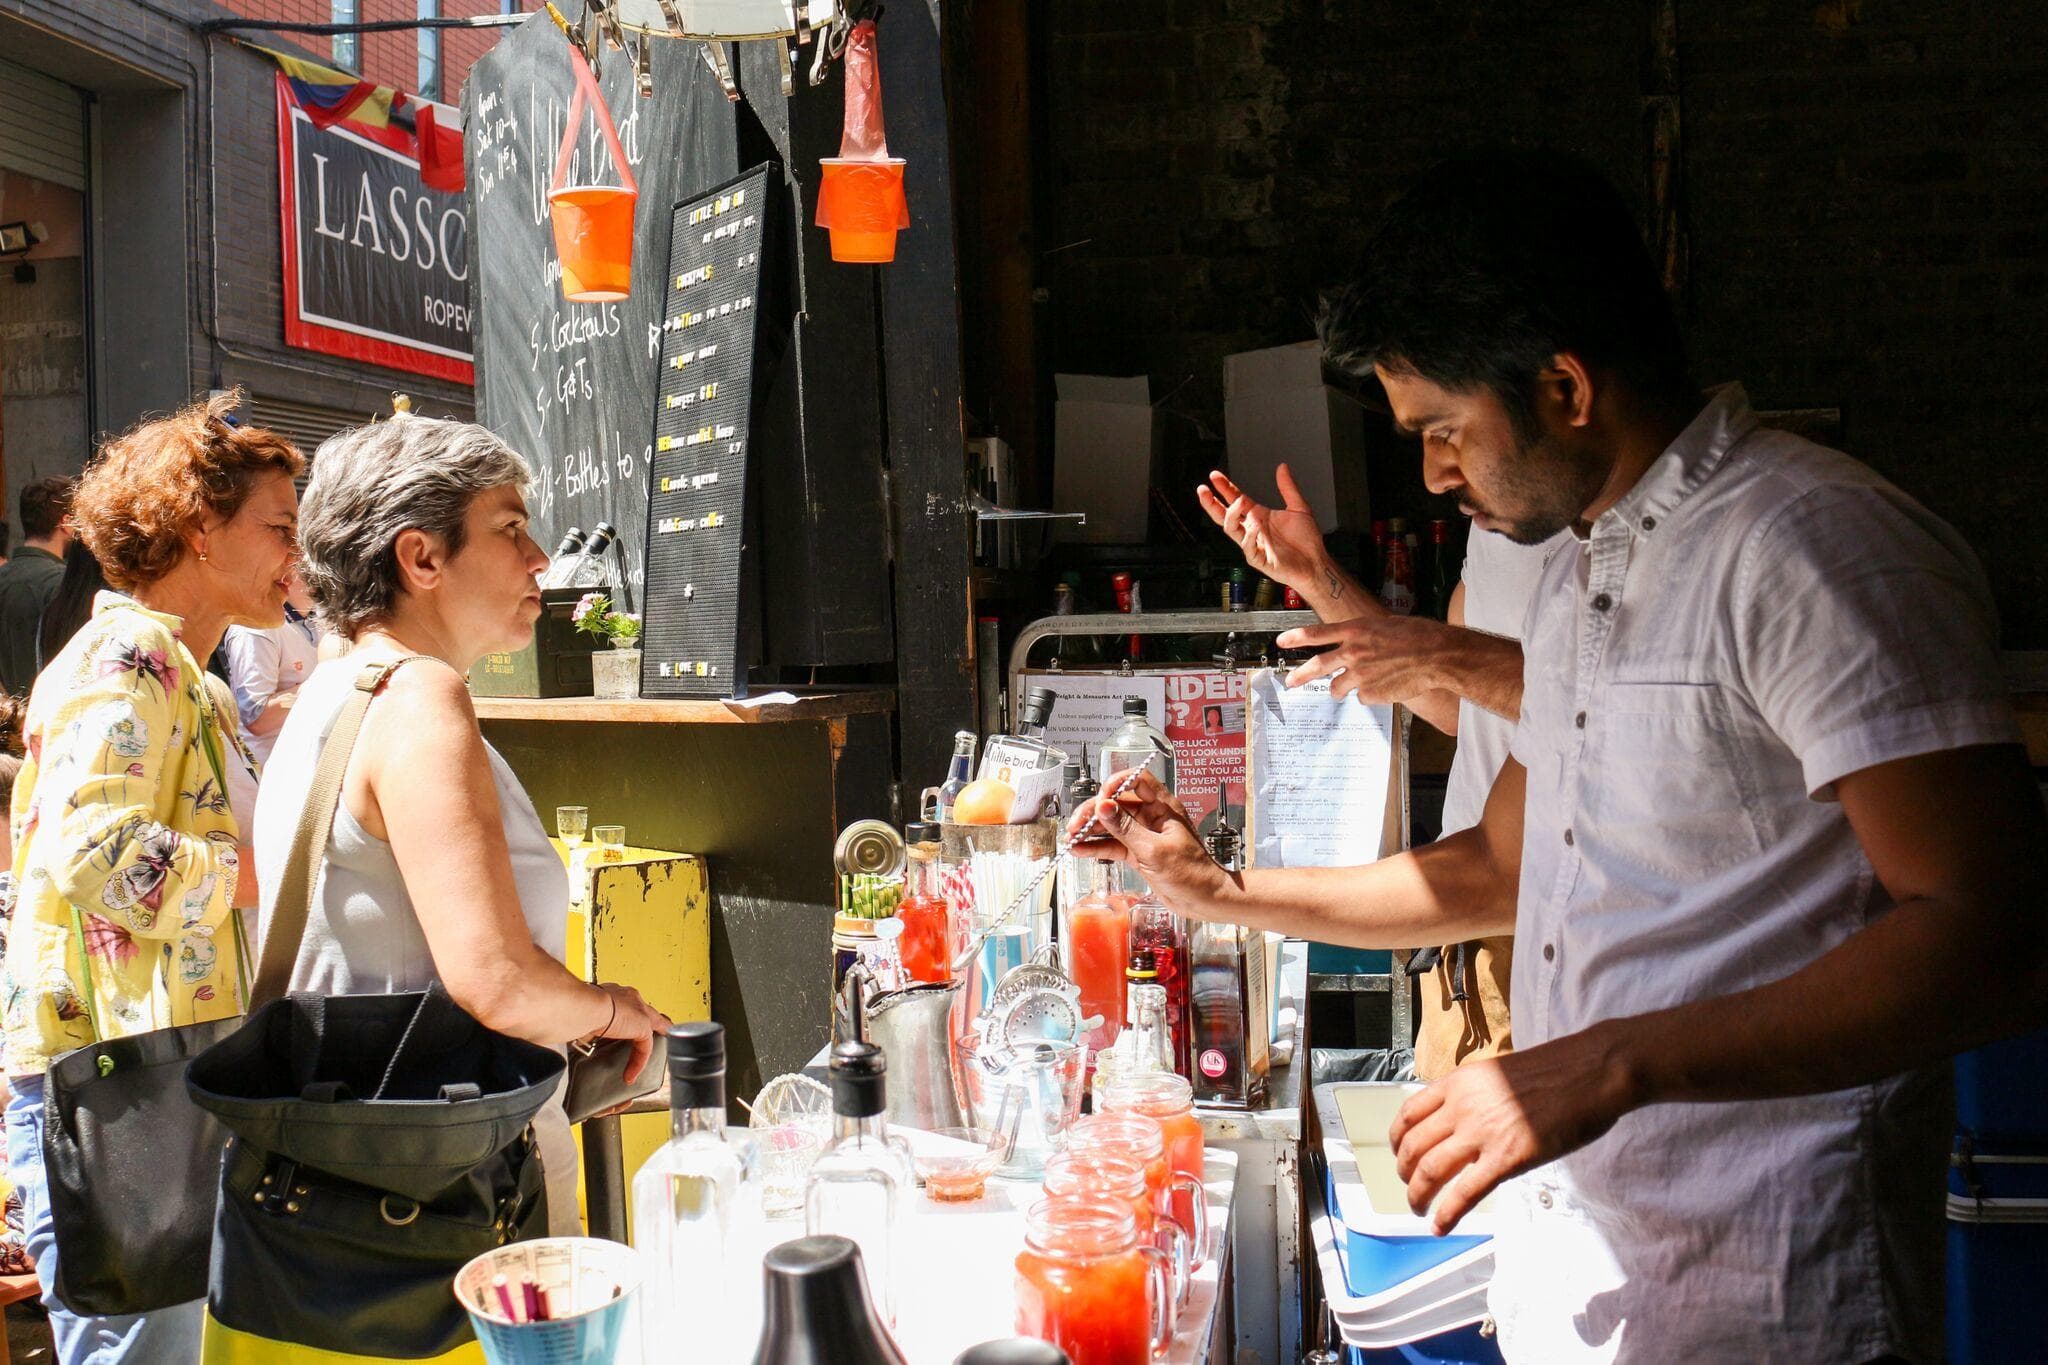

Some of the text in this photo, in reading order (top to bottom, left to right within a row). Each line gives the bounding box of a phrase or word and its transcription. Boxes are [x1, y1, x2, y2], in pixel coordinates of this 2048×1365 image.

[477, 124, 493, 157] Sat
[479, 166, 494, 202] Sun
[689, 203, 714, 227] LITTLE
[551, 301, 621, 353] Cocktails
[565, 445, 610, 498] Bottles
[616, 430, 634, 480] to
[674, 661, 692, 678] LOVE
[1078, 713, 1102, 722] supplied
[1187, 739, 1218, 747] LUCKY
[990, 748, 1035, 770] little bird
[1177, 749, 1189, 757] TO
[1191, 748, 1218, 757] LOOK
[1194, 758, 1207, 766] BE
[1209, 757, 1242, 766] ASKED
[1210, 767, 1230, 775] YOU
[1190, 778, 1217, 787] OVER
[1206, 1055, 1221, 1065] UK
